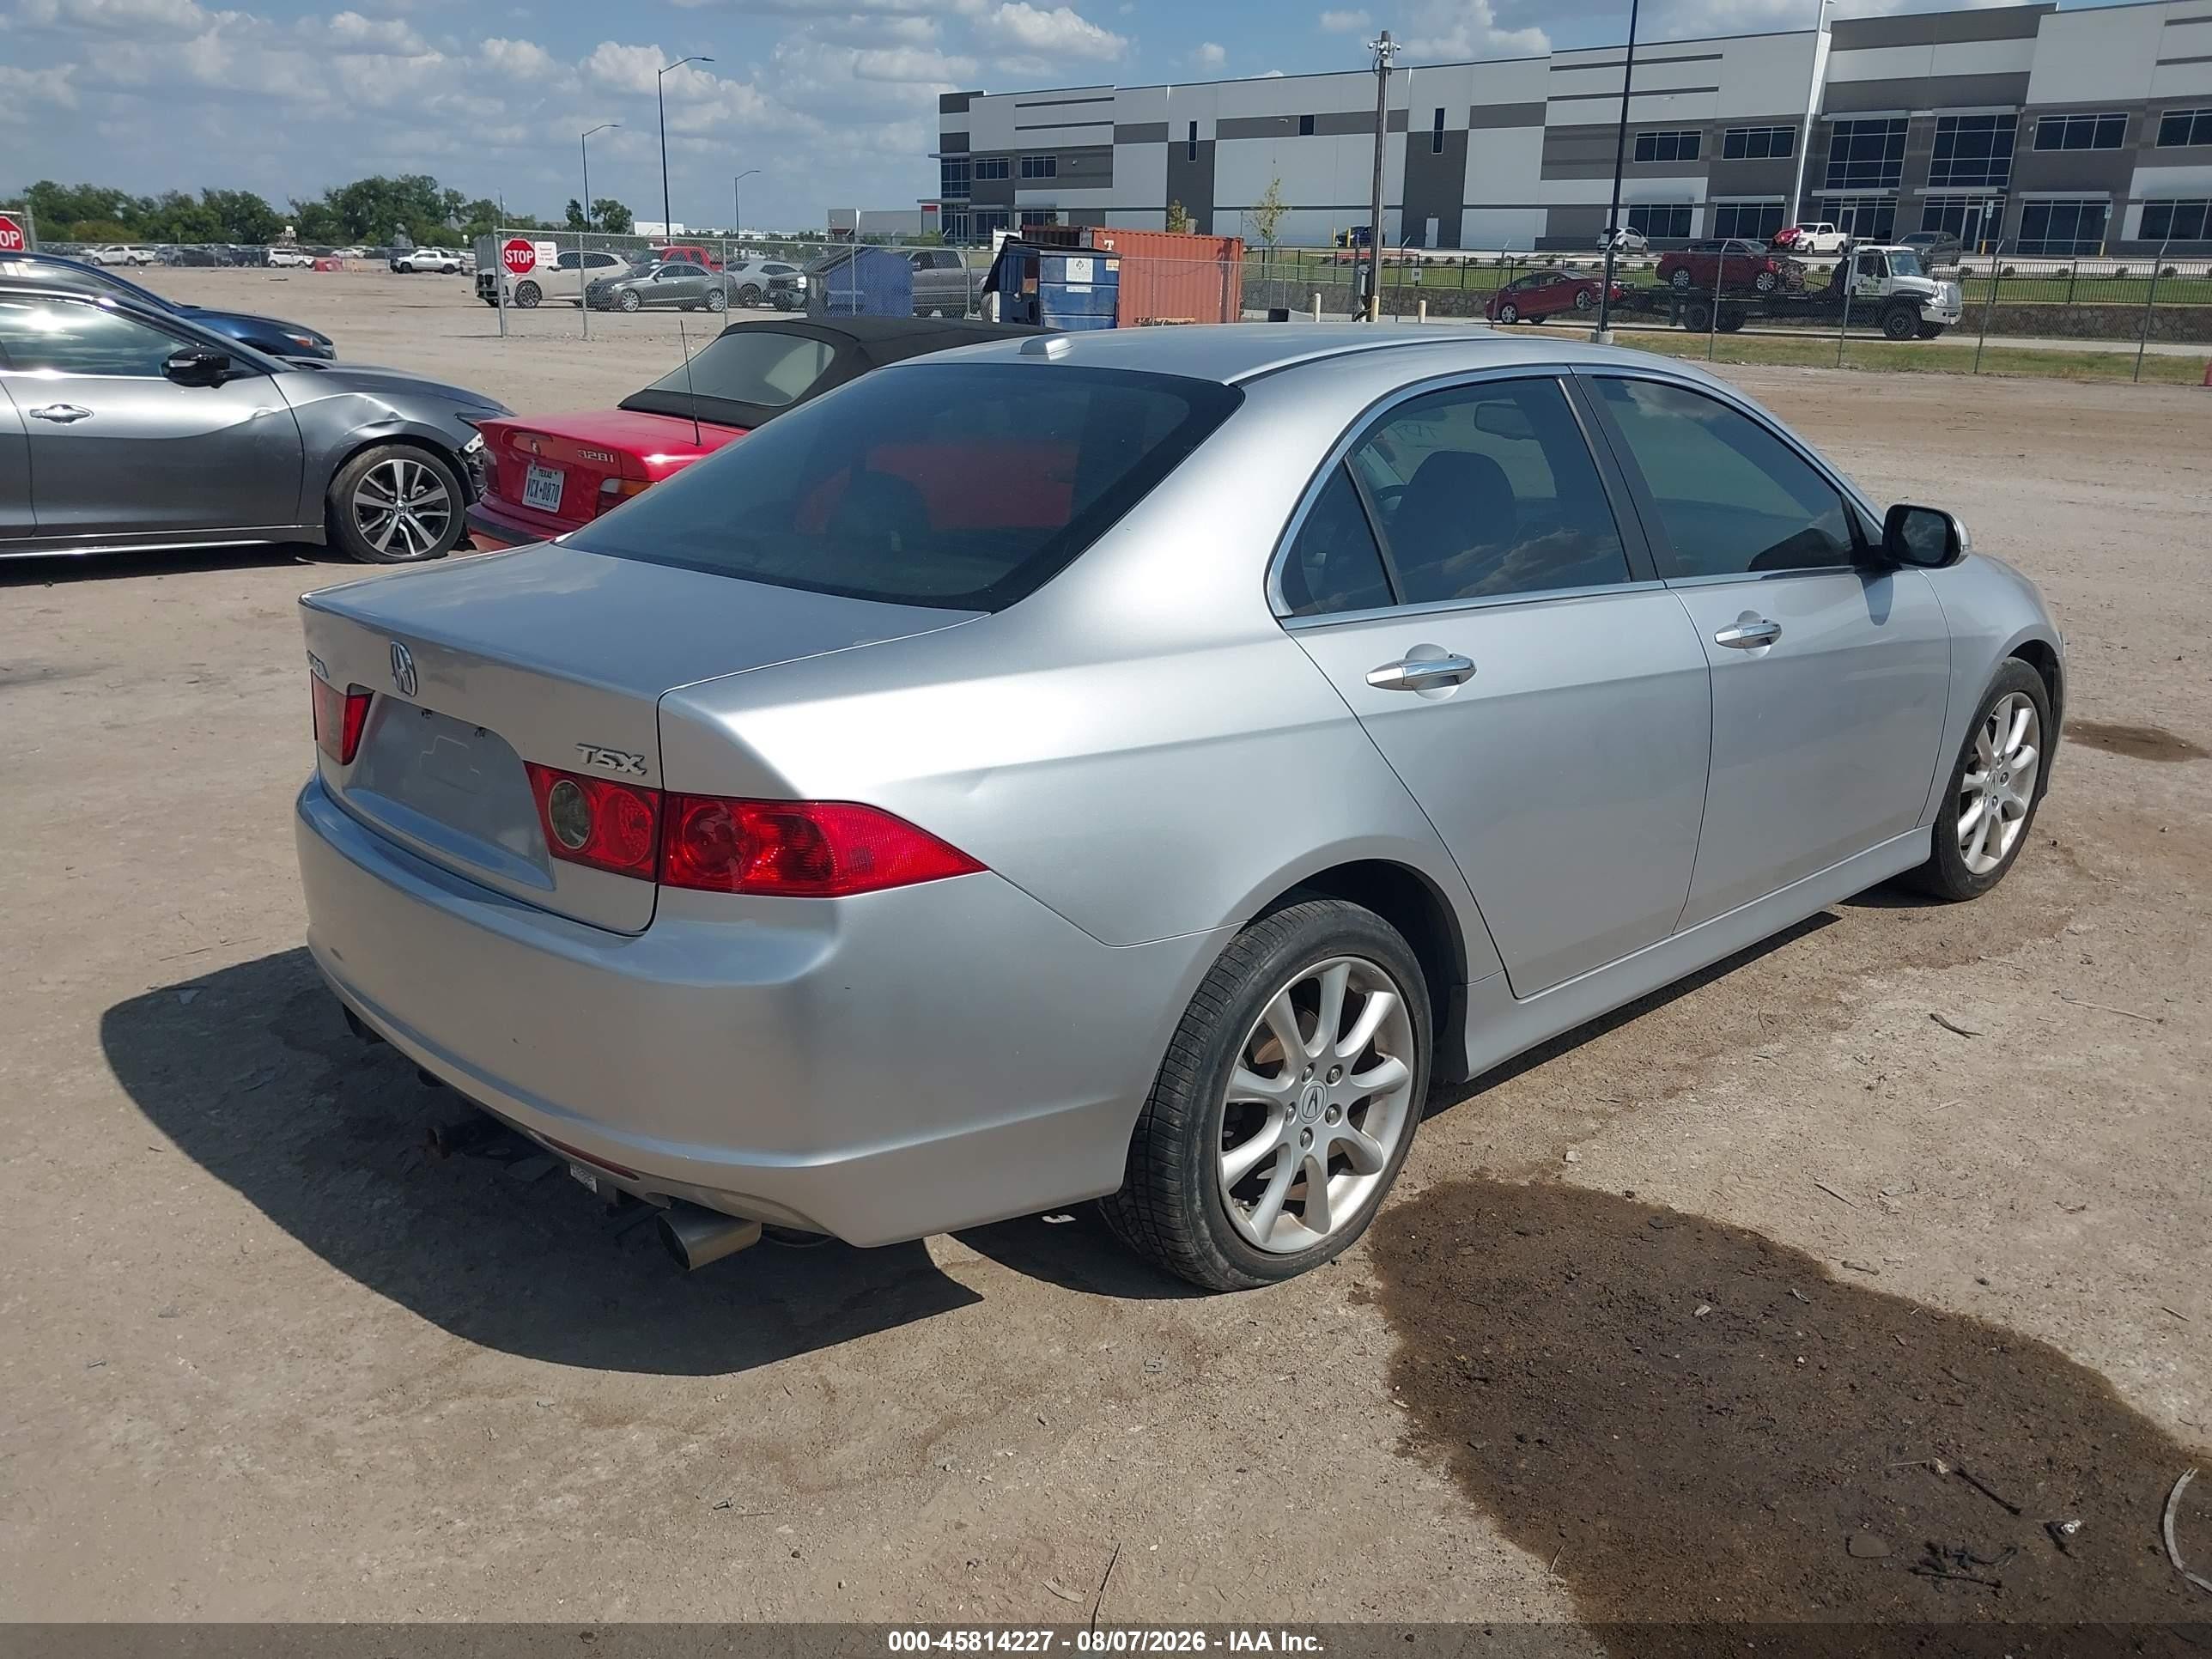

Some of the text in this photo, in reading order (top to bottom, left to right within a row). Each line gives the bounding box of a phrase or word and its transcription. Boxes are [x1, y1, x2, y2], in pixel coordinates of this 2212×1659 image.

[0, 230, 20, 247] OP
[505, 249, 534, 264] STOP
[538, 468, 552, 479] TEXAS
[574, 743, 647, 775] TSX
